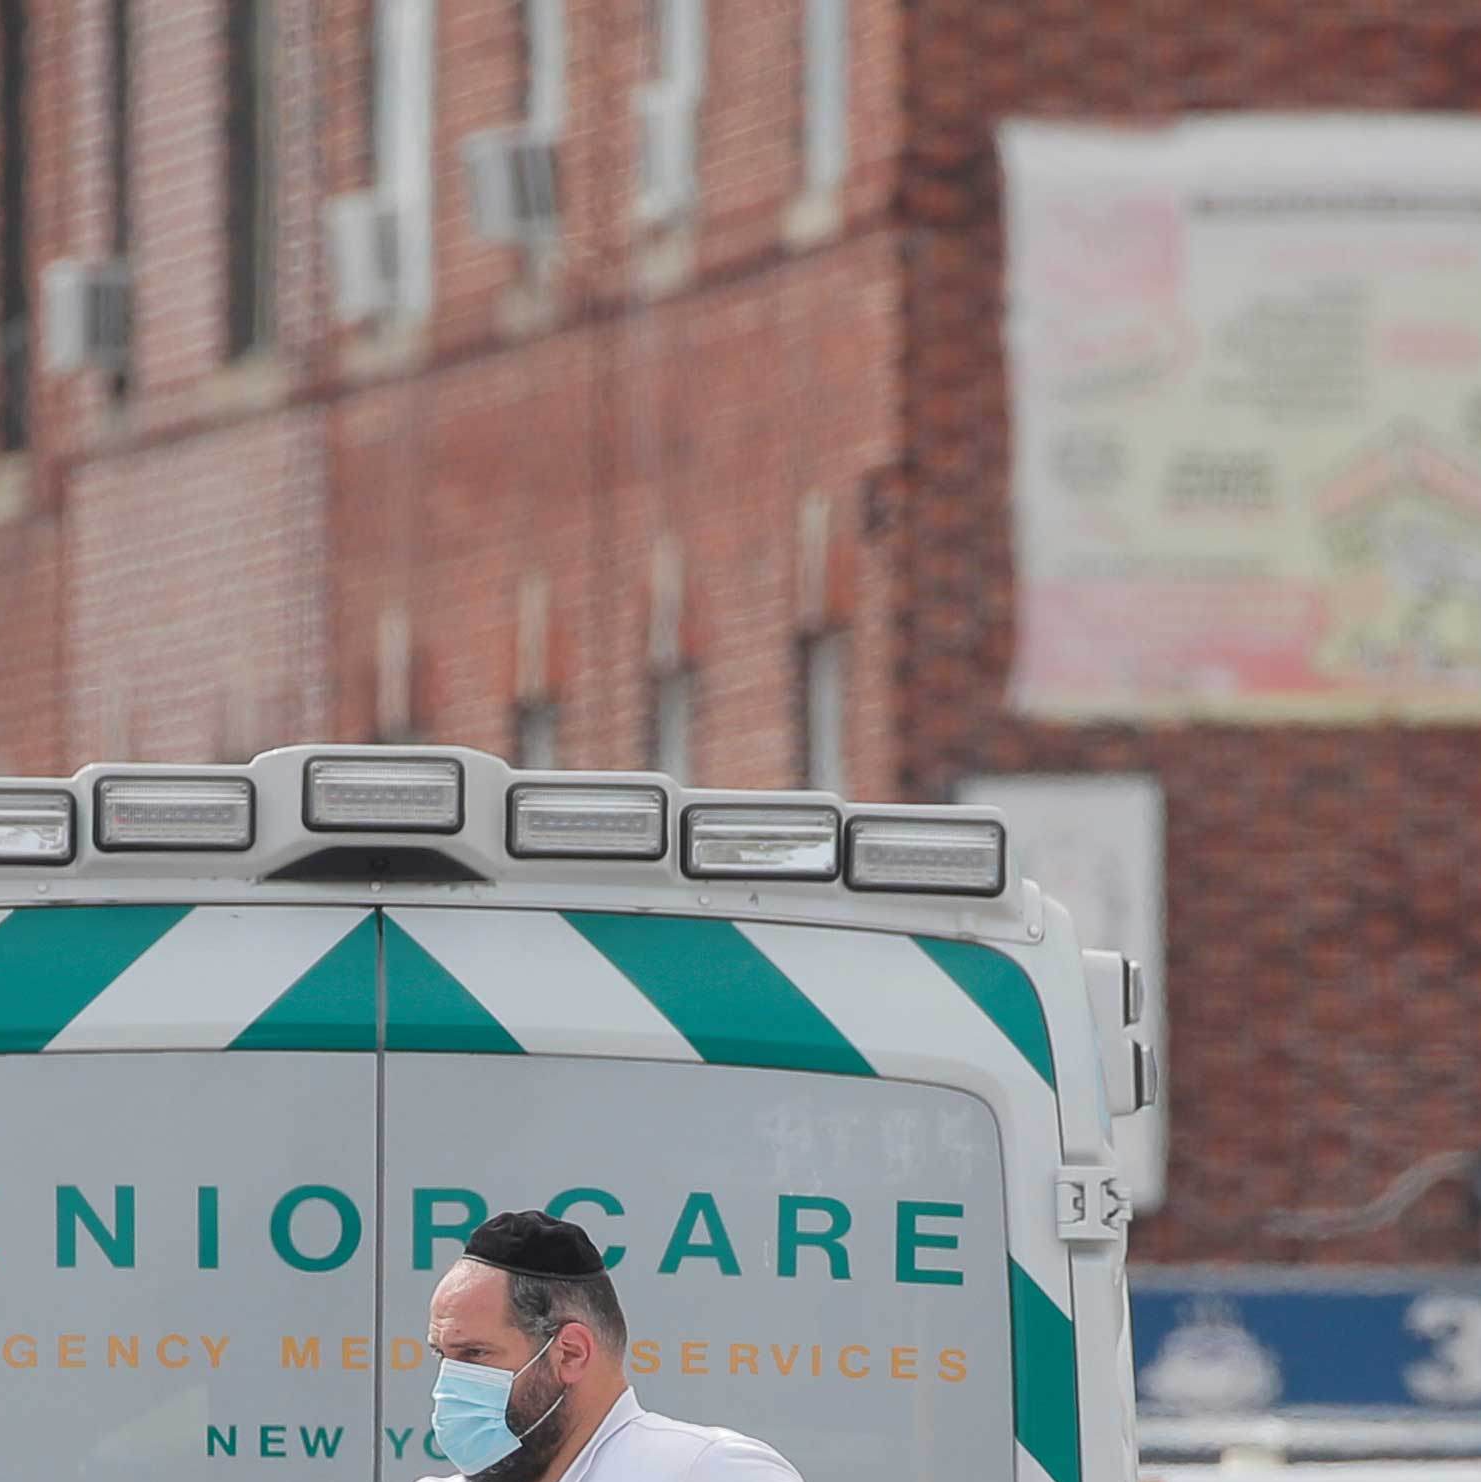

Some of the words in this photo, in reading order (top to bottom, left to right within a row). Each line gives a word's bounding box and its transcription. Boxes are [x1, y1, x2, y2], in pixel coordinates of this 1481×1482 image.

[629, 1339, 970, 1383] SERVICES
[205, 1425, 345, 1459] NEW
[385, 1427, 450, 1462] YO
